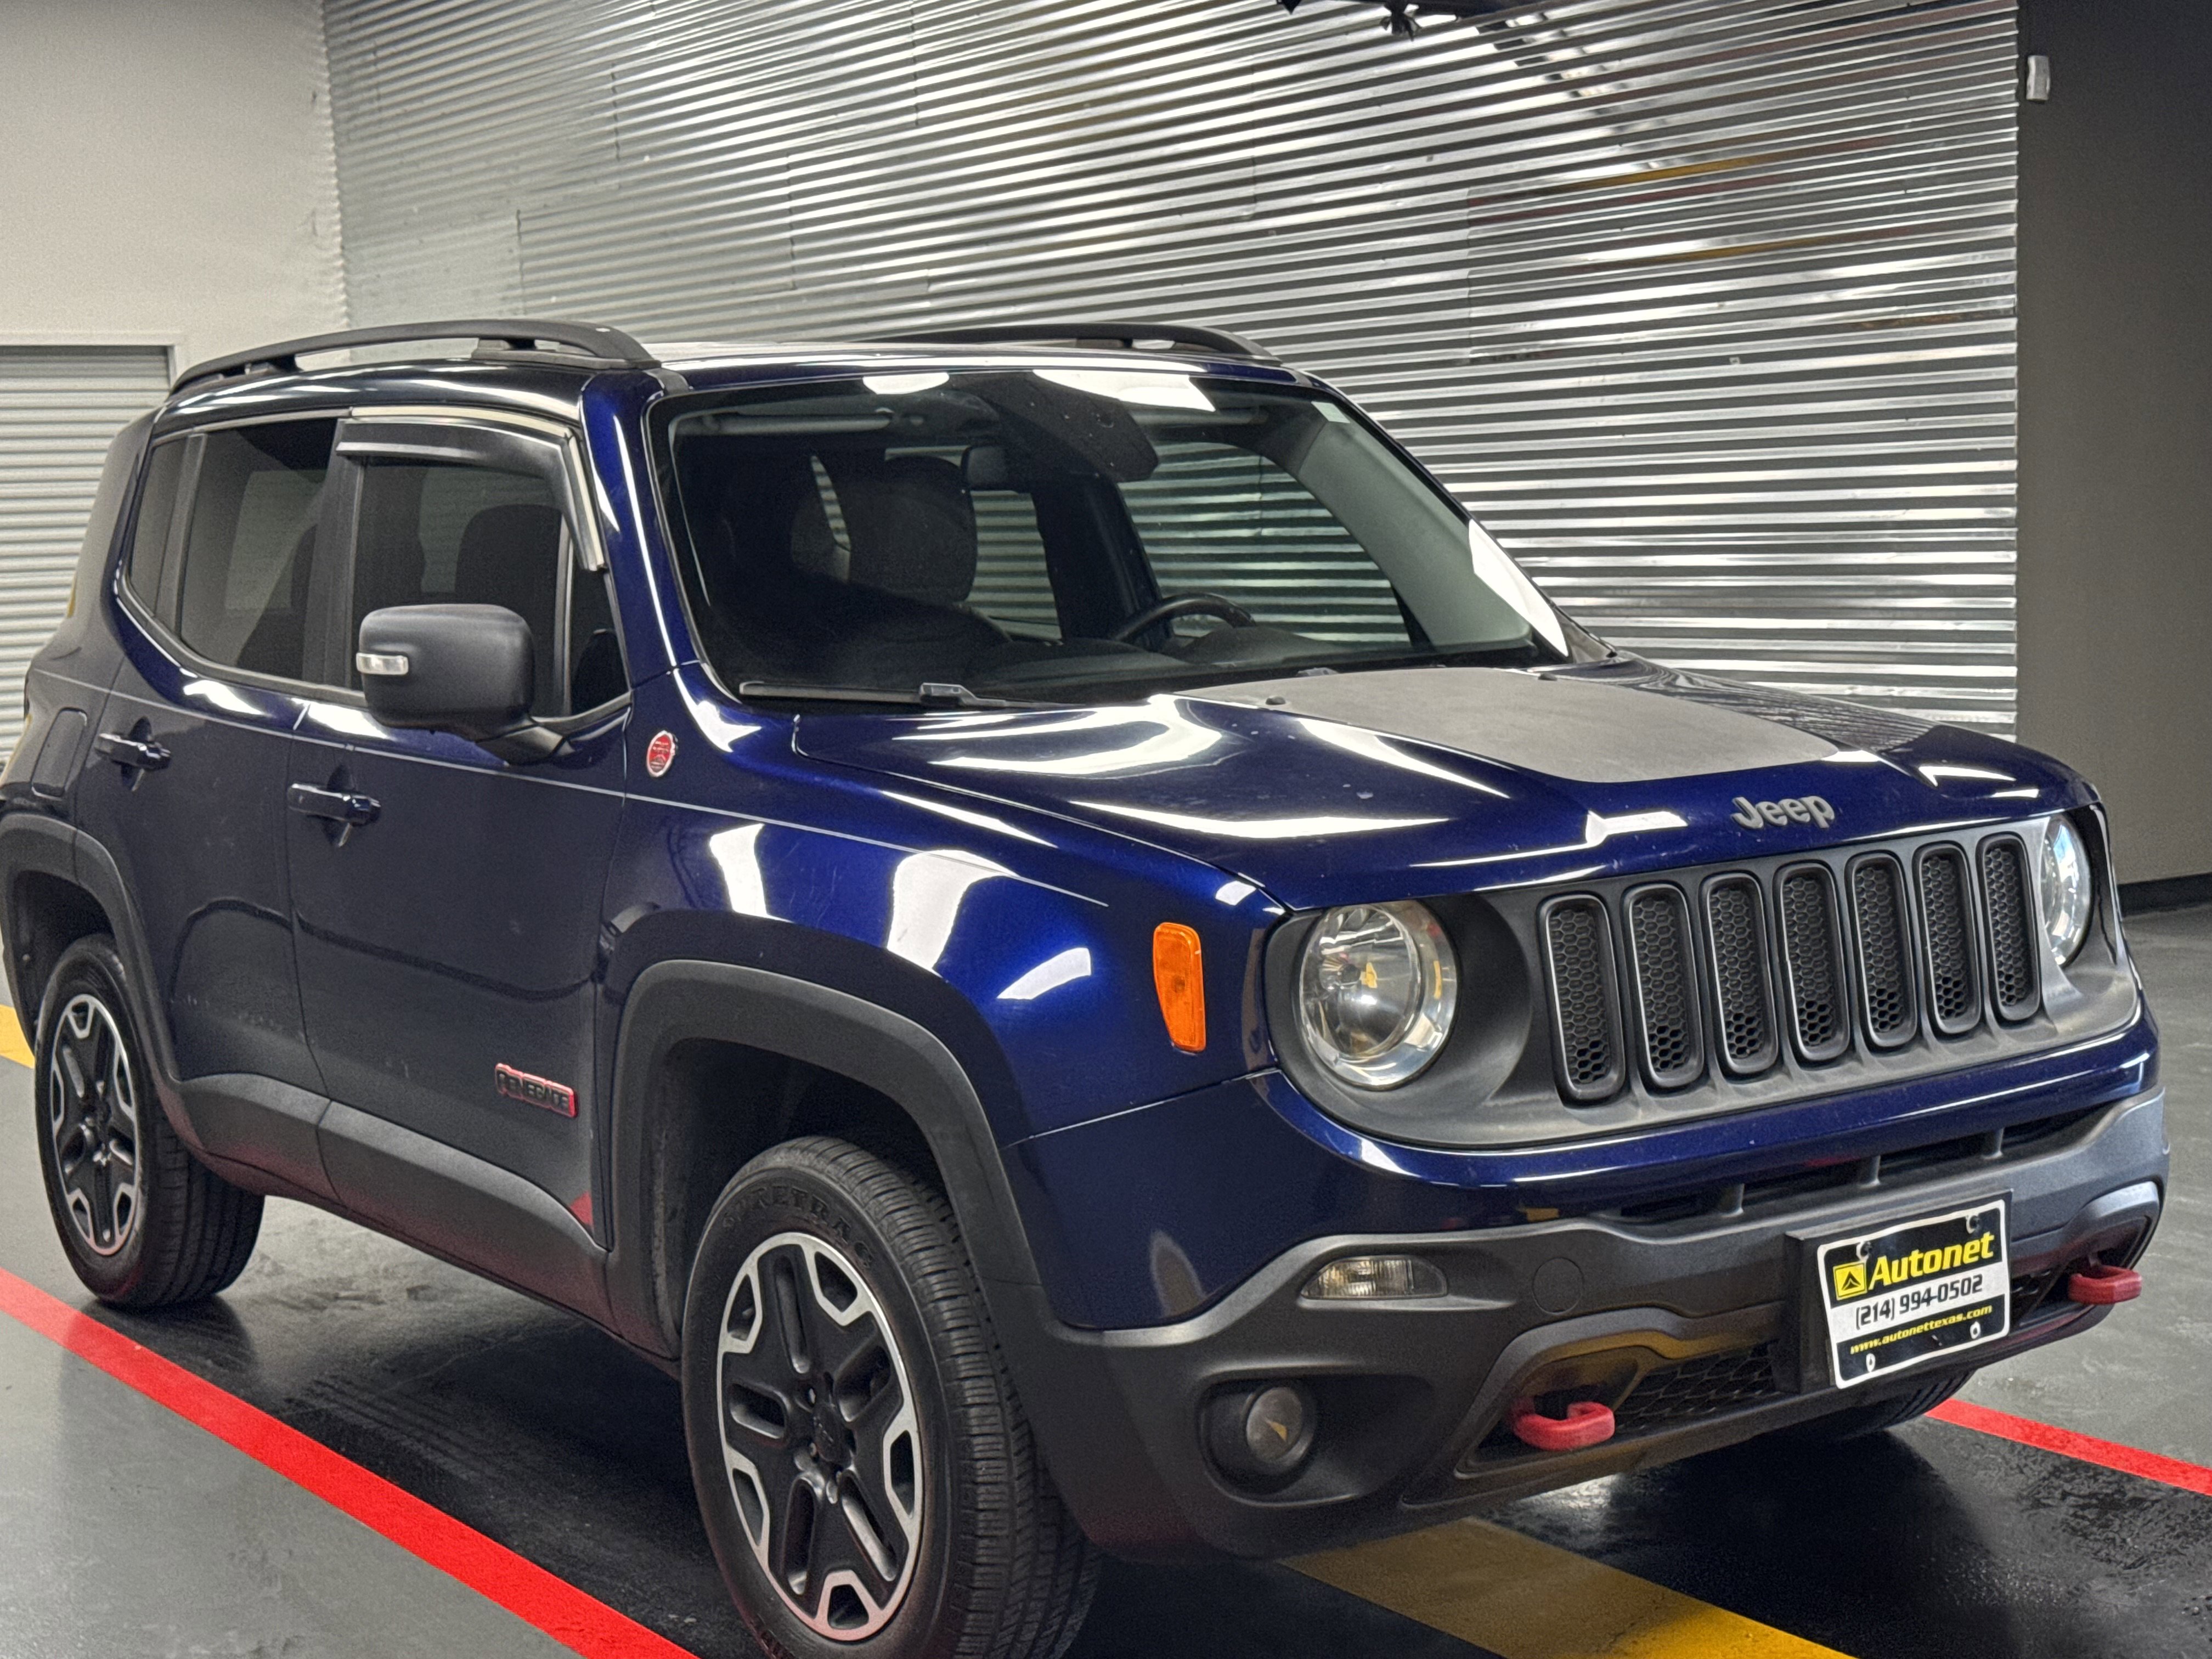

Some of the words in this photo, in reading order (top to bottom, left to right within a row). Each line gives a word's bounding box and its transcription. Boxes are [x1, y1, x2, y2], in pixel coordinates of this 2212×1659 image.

[1730, 795, 1835, 829] Jeep
[1868, 1232, 1995, 1290] Autonet
[1856, 1298, 1895, 1330] (214)
[1899, 1274, 1983, 1314] 994-0502
[1850, 1305, 1993, 1355] www.autonettexas.com
